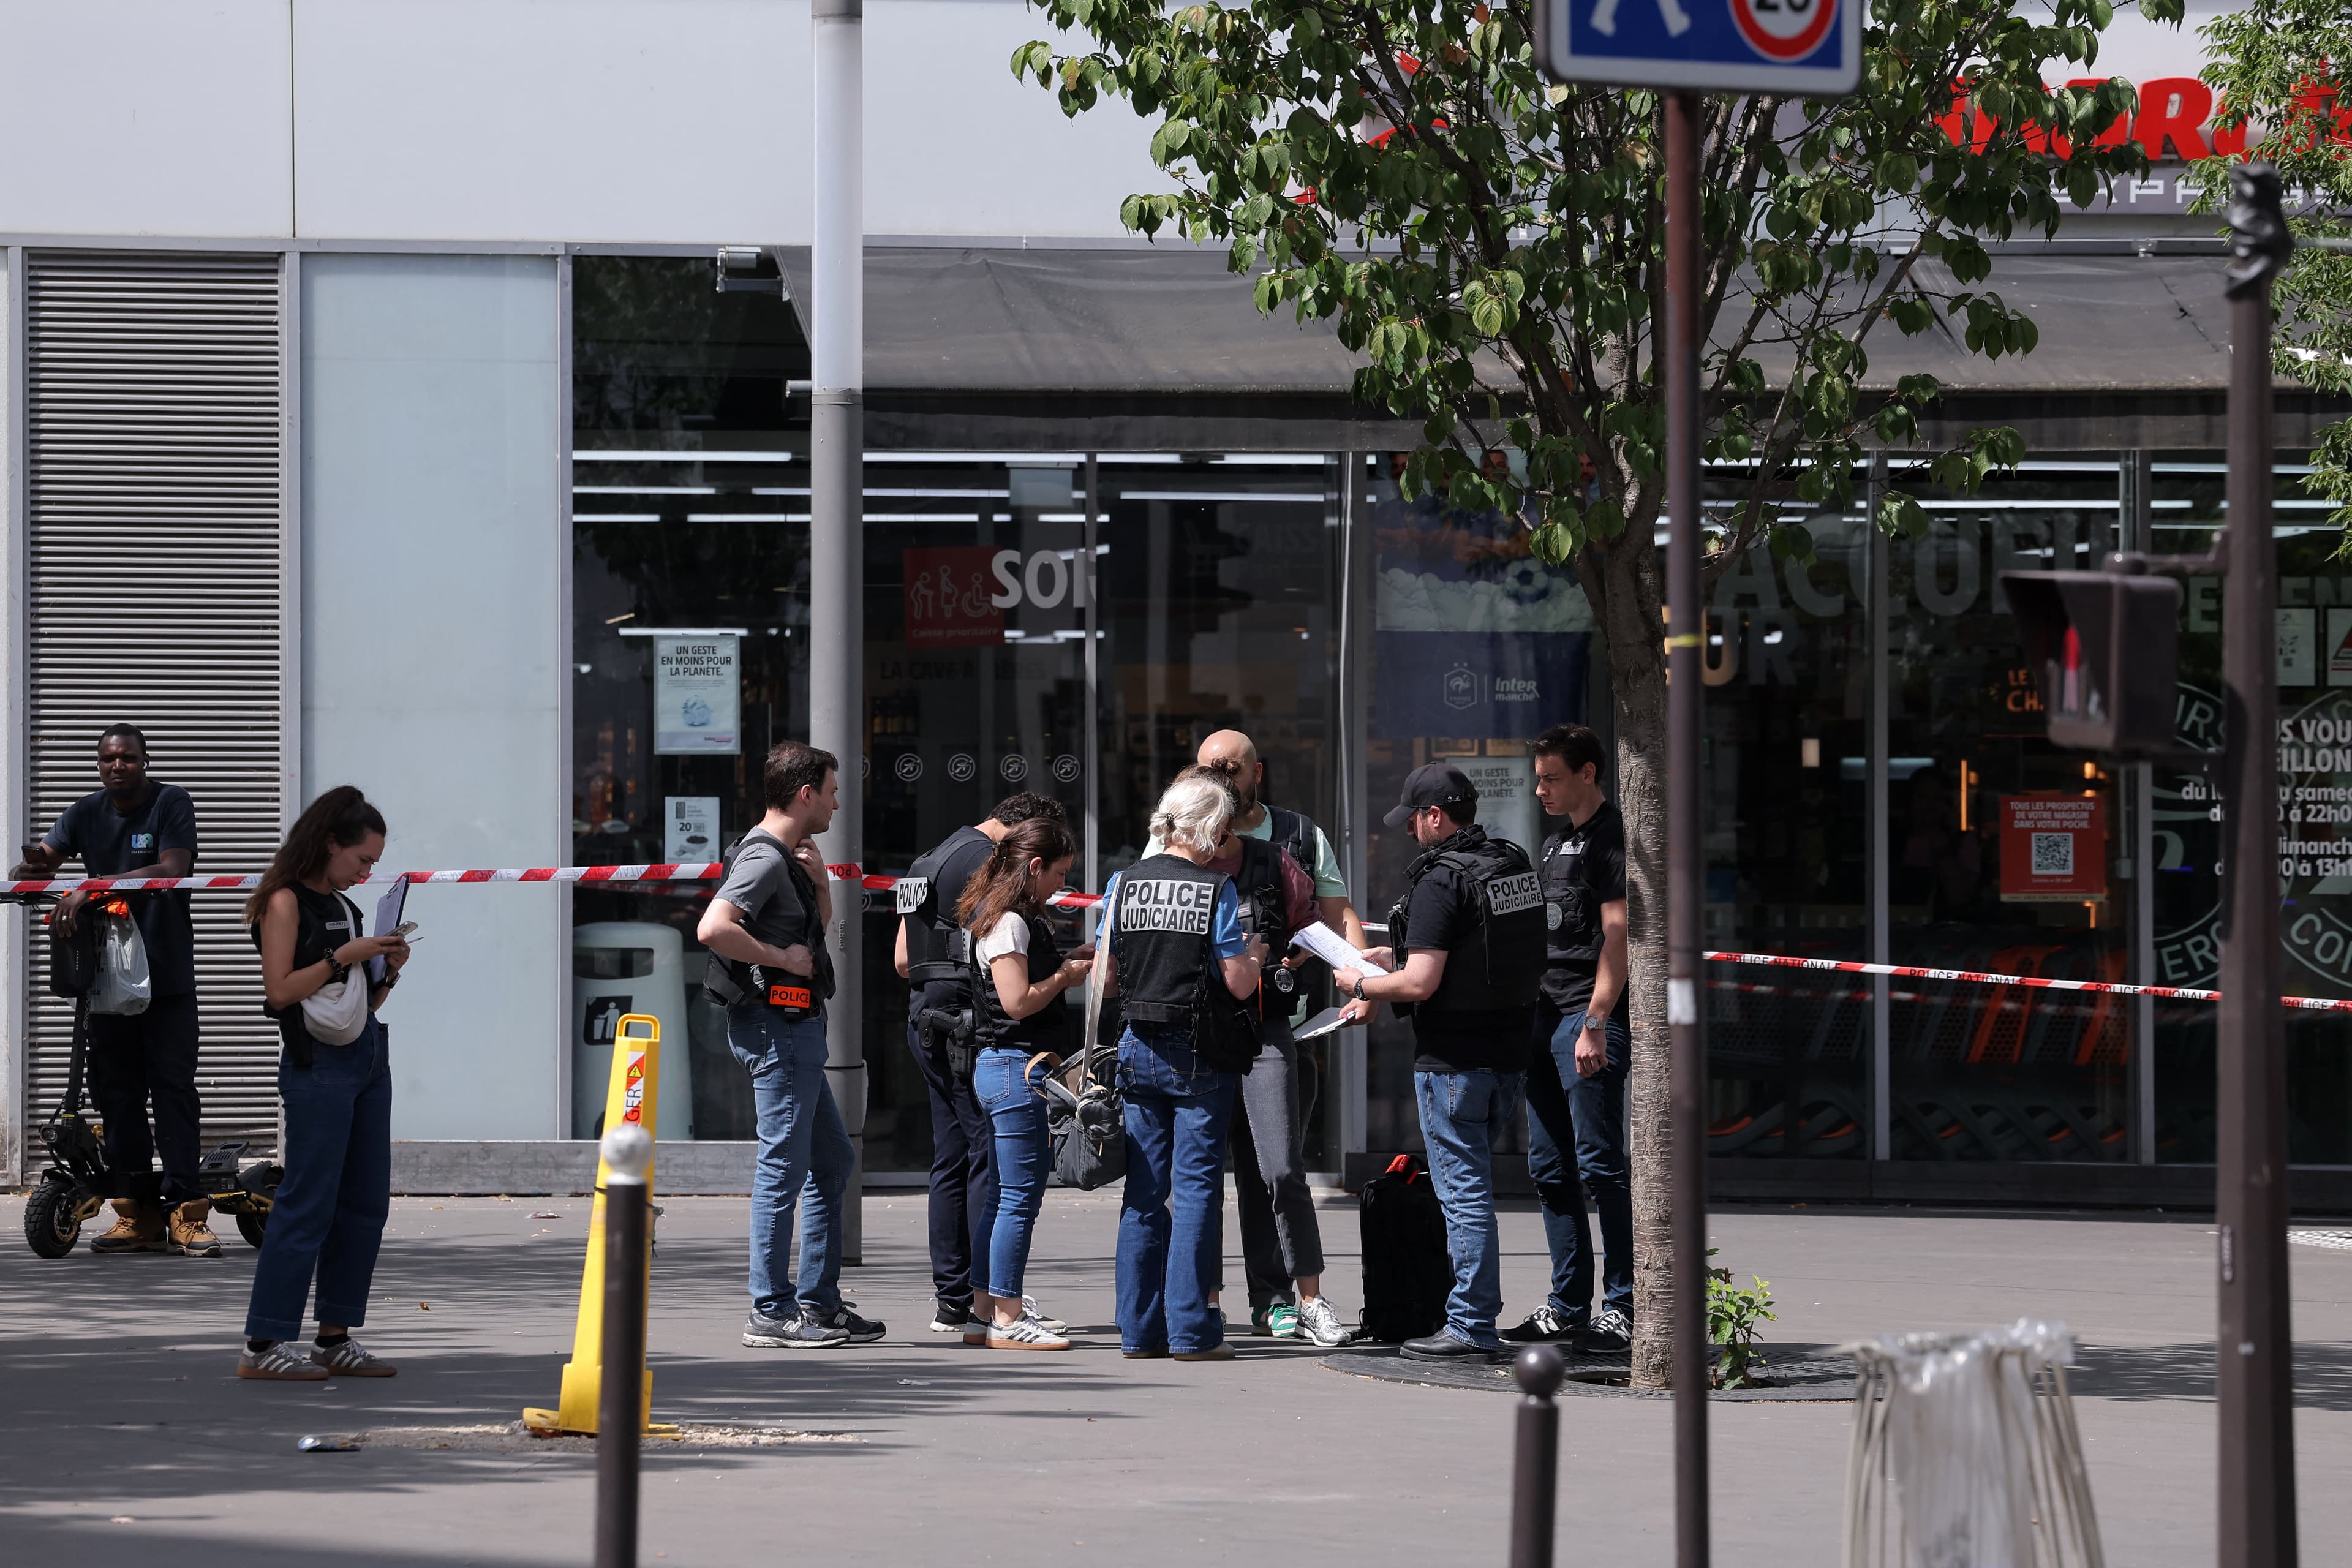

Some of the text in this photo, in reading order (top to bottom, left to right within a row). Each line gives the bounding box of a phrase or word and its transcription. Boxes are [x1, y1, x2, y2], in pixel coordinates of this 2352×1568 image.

[912, 626, 1000, 639] Caisse prioritaire
[676, 646, 717, 655] UN GESTE
[662, 656, 732, 665] EN MOINS POUR
[670, 666, 680, 676] LA
[2006, 689, 2045, 712] CH
[1470, 768, 1510, 777] UN GESTE
[1500, 778, 1524, 788] POUR
[2181, 782, 2206, 801] du
[2032, 801, 2044, 810] LES
[2015, 810, 2026, 819] DE
[679, 822, 692, 832] 20
[1490, 875, 1537, 899] POLICE
[899, 883, 927, 908] POLICE
[1123, 881, 1212, 909] POLICE
[1493, 892, 1542, 911] JUDICIAIRE
[1122, 907, 1208, 932] JUDICIAIRE
[1727, 954, 1842, 970] POLICE NATIONALE
[1909, 969, 2027, 985] POLICE NATIONALE
[772, 990, 809, 1003] POLICE
[2095, 984, 2214, 1000] POLICE NATIONALE
[2283, 999, 2328, 1009] POLICE
